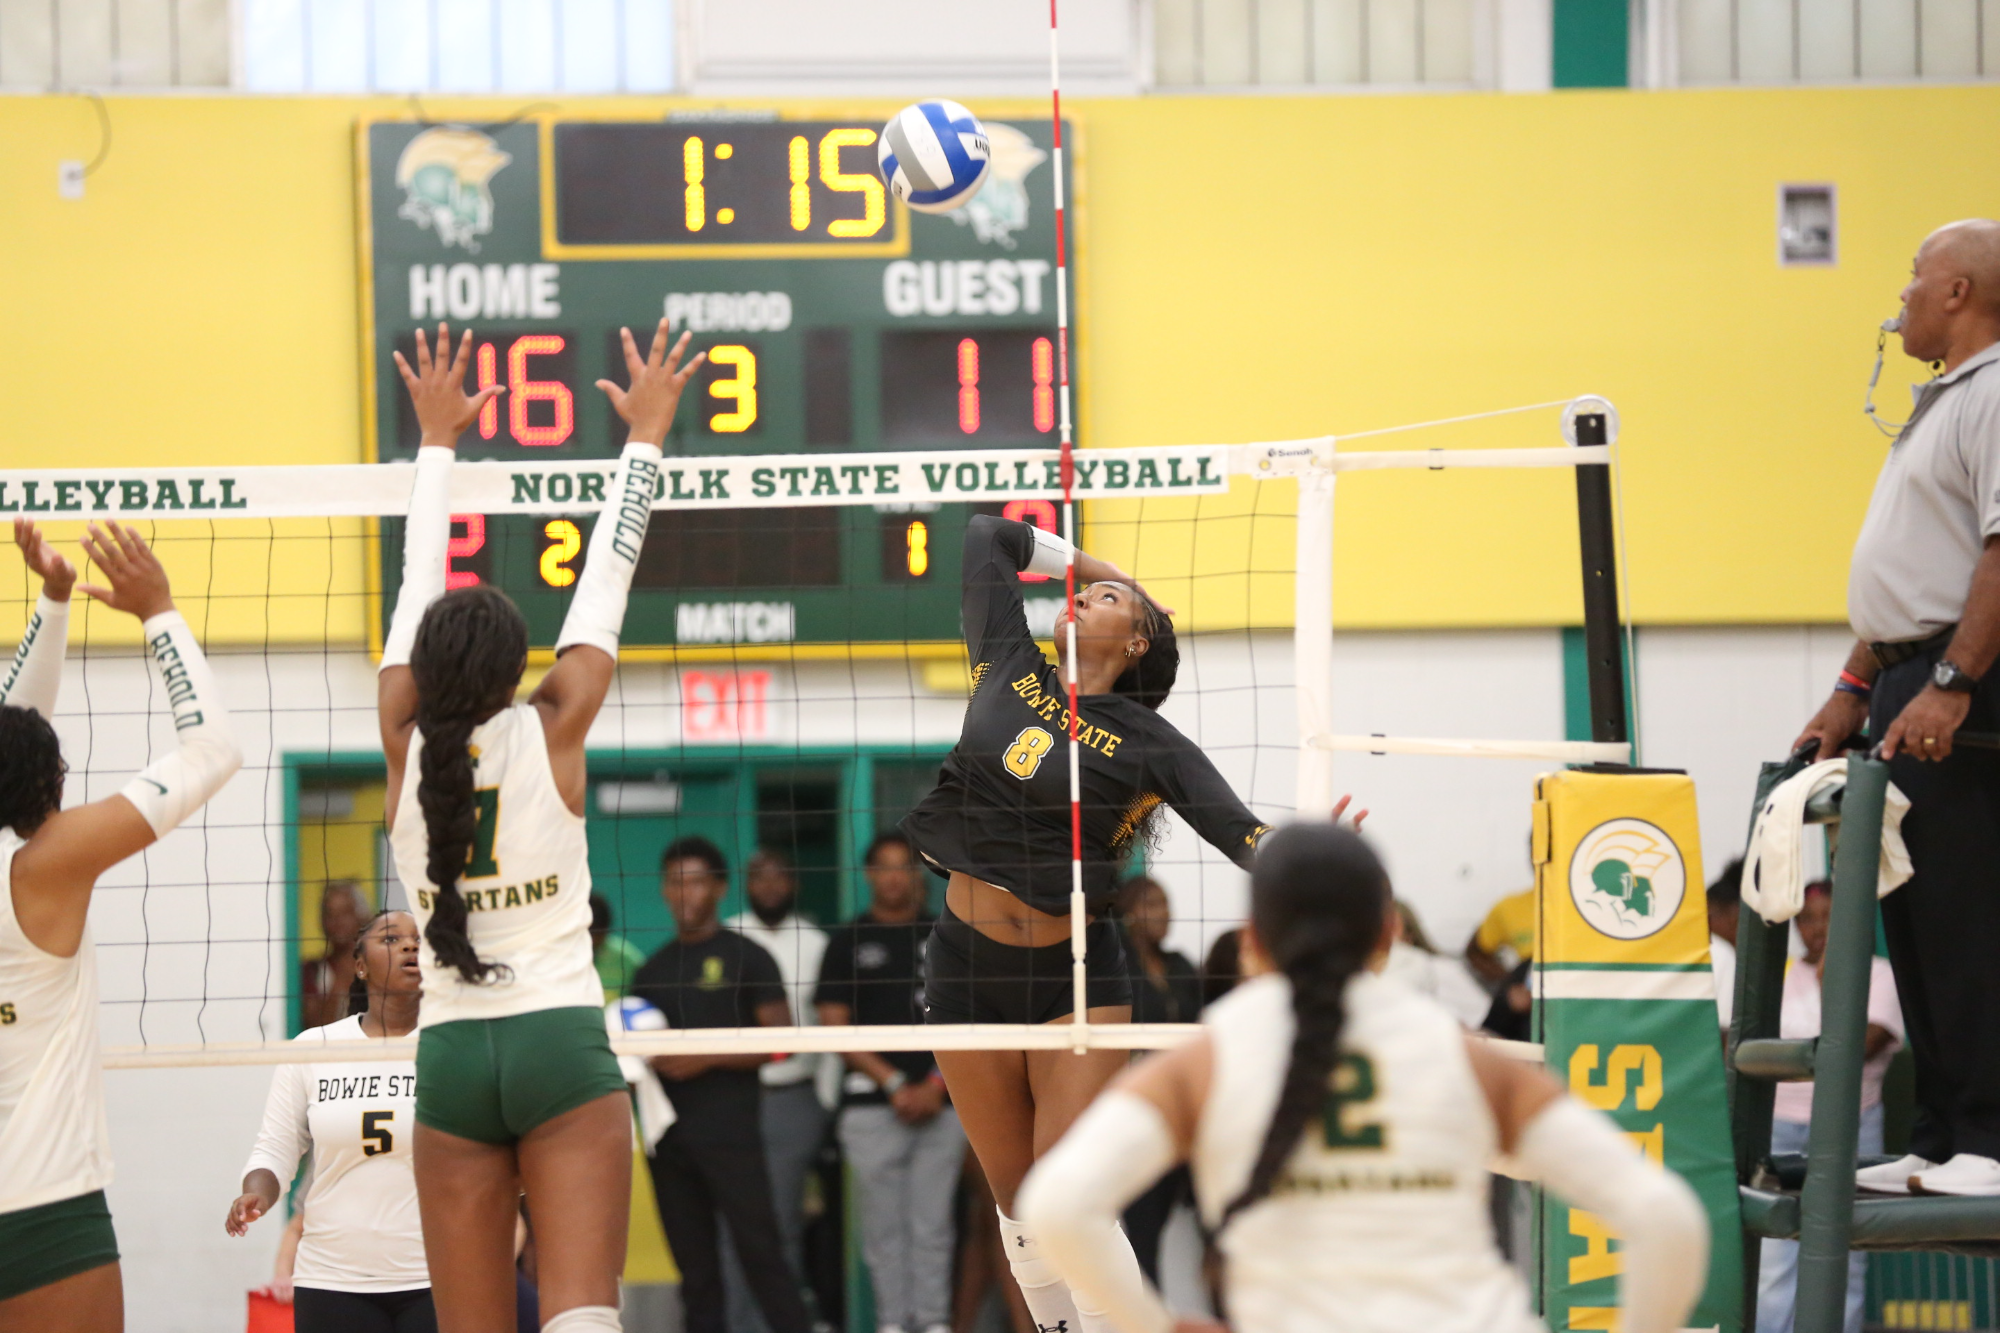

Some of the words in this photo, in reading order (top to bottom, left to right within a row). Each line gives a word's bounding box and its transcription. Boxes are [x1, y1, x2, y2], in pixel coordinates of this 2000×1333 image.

[684, 128, 886, 238] 1:15
[410, 264, 560, 319] HOME
[664, 292, 792, 333] PERIOD
[883, 259, 1049, 317] GUEST
[478, 335, 574, 447] 16
[708, 345, 757, 433] 3
[957, 338, 1055, 433] 11
[751, 465, 899, 498] STATE
[921, 457, 1222, 493] VOLLEYBALL
[613, 458, 657, 564] BEHOLD
[540, 520, 581, 587] 2
[907, 521, 928, 576] 1
[676, 601, 796, 643] MATCH
[681, 669, 772, 740] EXIT
[1002, 726, 1055, 780] 8
[318, 1075, 381, 1103] BOWIE
[388, 1075, 417, 1097] ST
[1322, 1051, 1387, 1149] 2
[362, 1110, 395, 1157] 5
